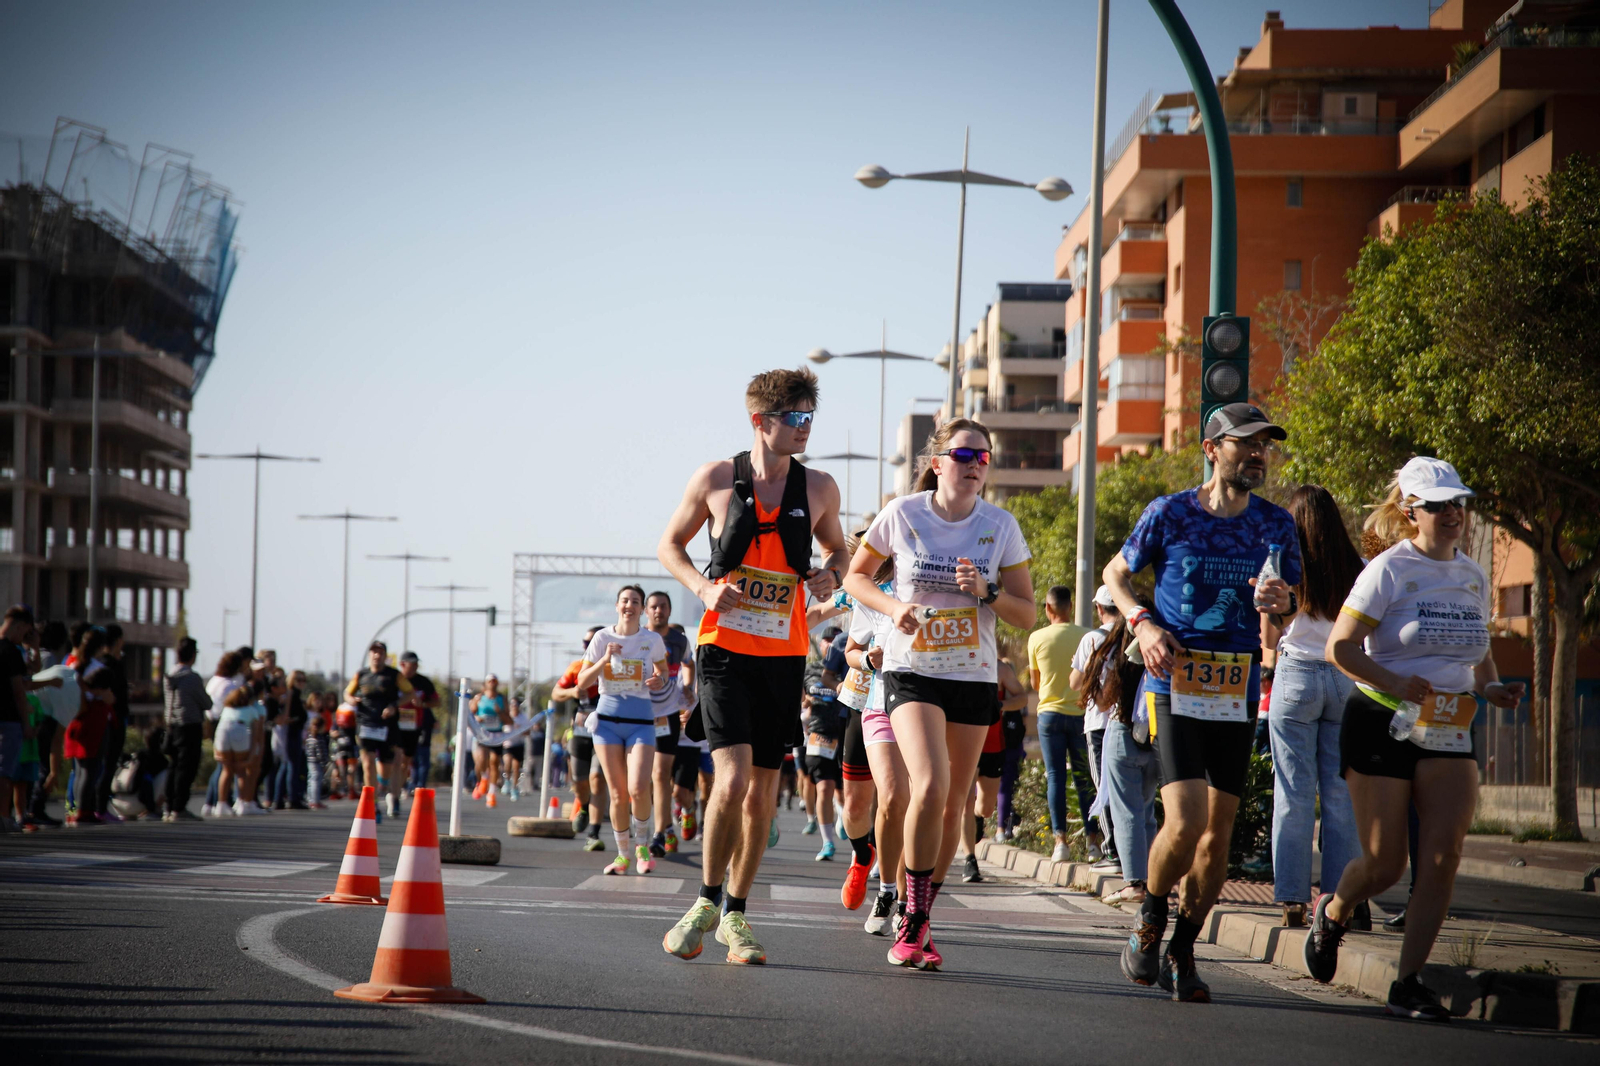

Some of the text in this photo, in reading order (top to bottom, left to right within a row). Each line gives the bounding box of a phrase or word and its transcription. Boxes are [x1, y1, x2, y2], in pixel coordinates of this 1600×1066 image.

[914, 551, 944, 562] Medio
[912, 560, 956, 573] Almería
[1204, 563, 1254, 573] UNIVERSIDAD
[736, 577, 790, 604] 1032
[740, 597, 774, 609] ALEXANDRE
[1417, 601, 1446, 609] Medio
[1418, 609, 1460, 620] Almería
[920, 618, 973, 640] 1033
[1183, 662, 1242, 685] 1318
[1434, 695, 1459, 716] 94
